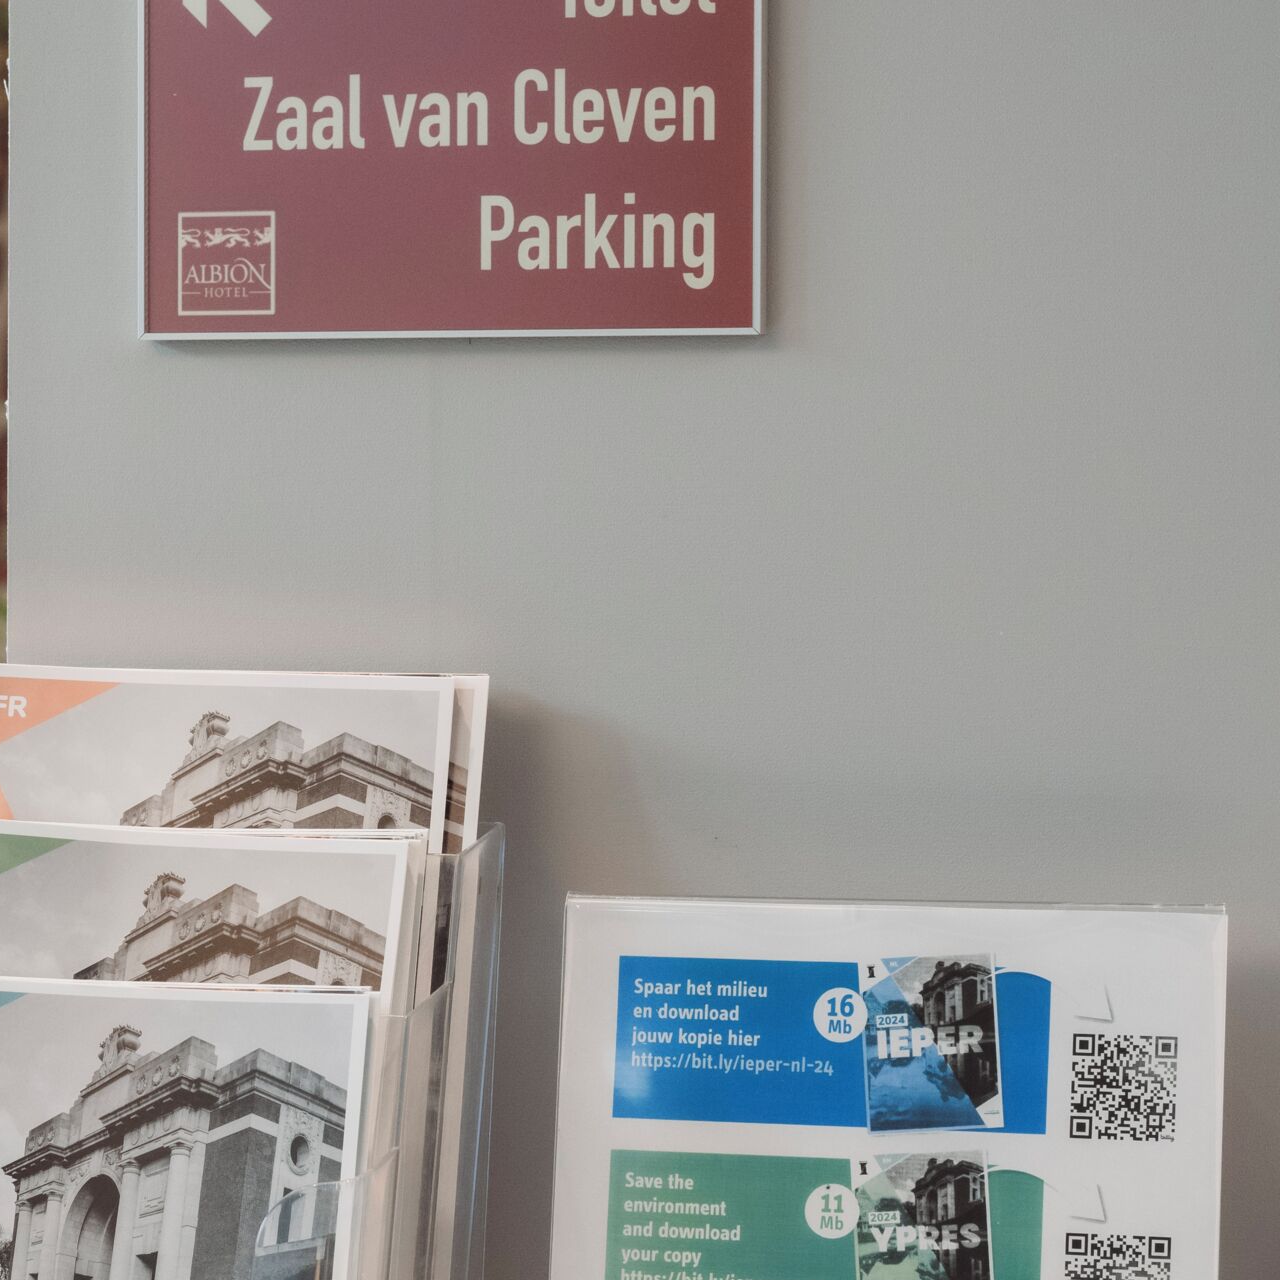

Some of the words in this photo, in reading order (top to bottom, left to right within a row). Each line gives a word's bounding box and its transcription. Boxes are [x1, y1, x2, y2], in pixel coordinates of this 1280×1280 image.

[243, 74, 365, 151] Zaal
[382, 91, 488, 148] van
[514, 68, 715, 146] Cleven
[480, 192, 715, 290] Parking
[184, 258, 270, 287] ALBION
[204, 287, 248, 298] HOTEL
[634, 978, 681, 997] Spaar
[687, 979, 712, 996] het
[717, 981, 768, 998] milieu
[633, 1006, 652, 1018] en
[658, 1003, 739, 1021] download
[827, 994, 854, 1017] 16
[828, 1020, 852, 1034] Mb
[879, 1016, 905, 1025] 2024
[631, 1027, 672, 1046] jouw
[679, 1028, 722, 1048] kopie
[728, 1030, 760, 1046] hier
[877, 1025, 983, 1059] IEPER
[631, 1052, 834, 1076] https://bit.ly/ieper-nl-24
[625, 1172, 663, 1189] Save
[669, 1174, 694, 1190] the
[624, 1198, 726, 1216] environment
[821, 1193, 844, 1213] 11
[820, 1216, 844, 1230] Mb
[871, 1213, 897, 1222] 2024
[623, 1222, 653, 1237] and
[659, 1223, 740, 1241] download
[871, 1223, 981, 1252] YPRES
[621, 1248, 659, 1264] your
[664, 1251, 701, 1267] copy
